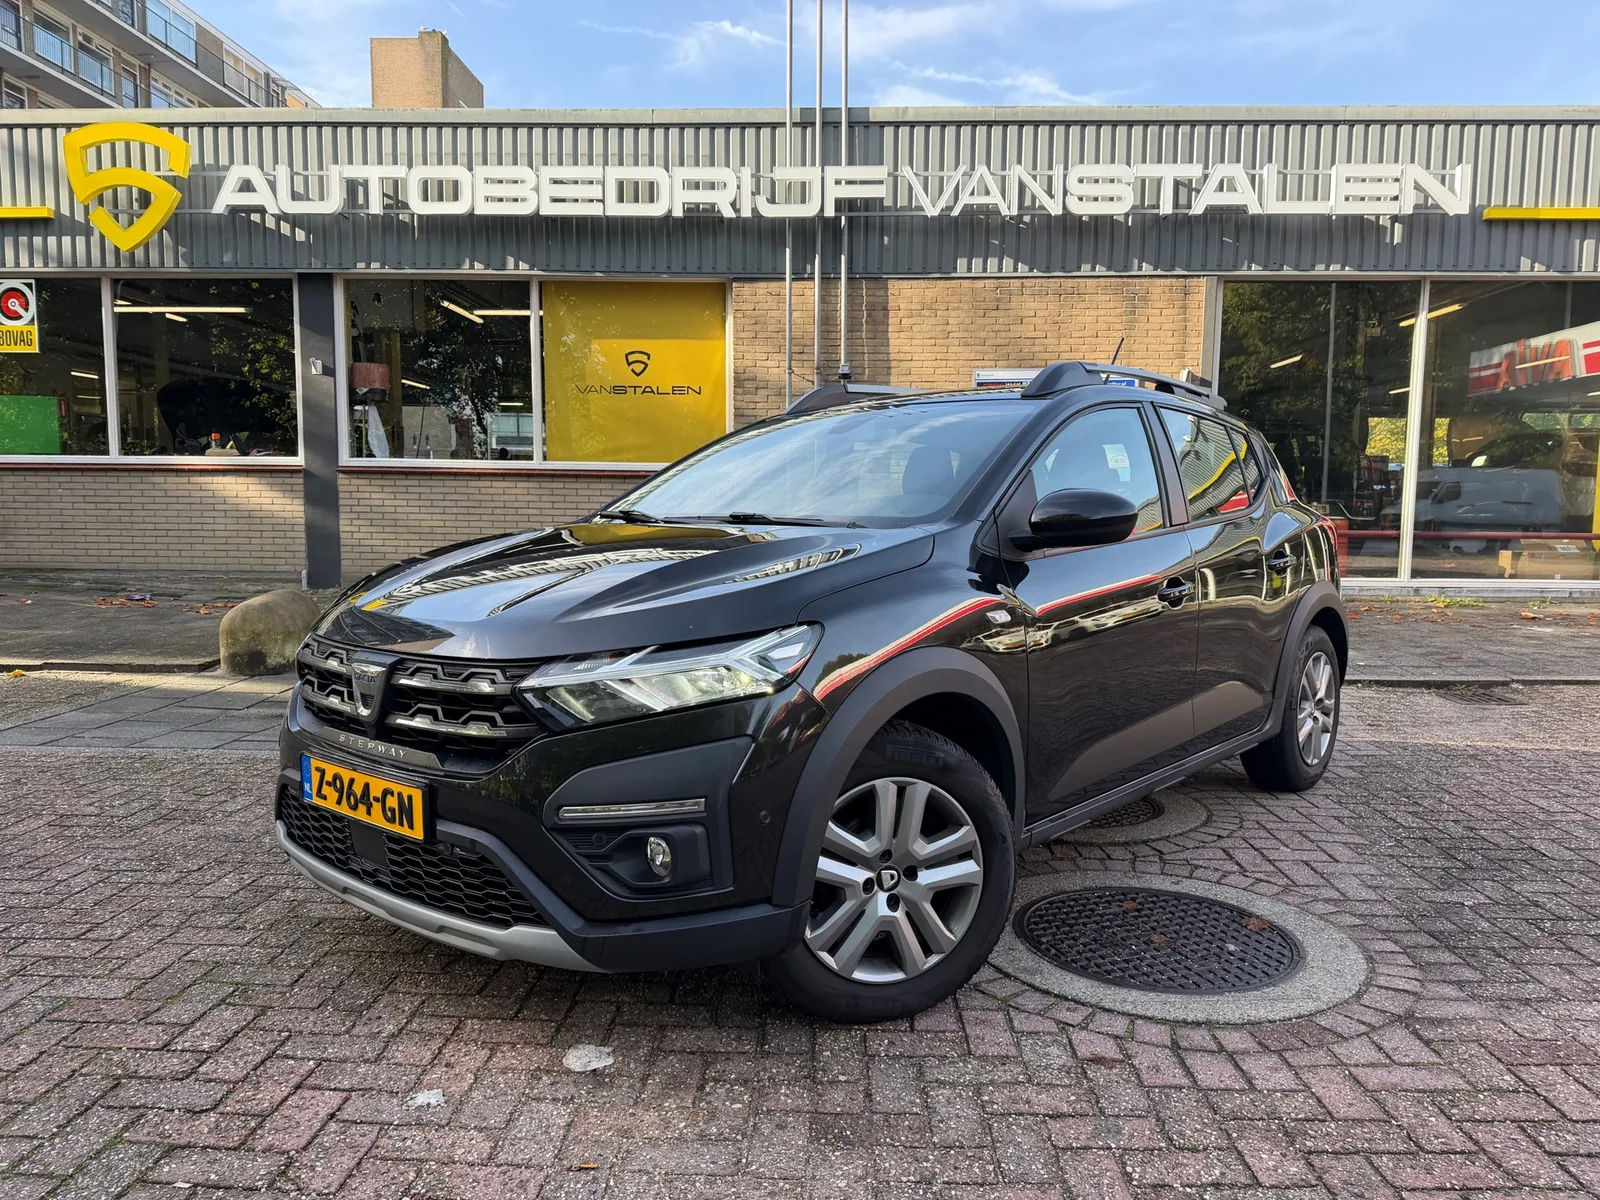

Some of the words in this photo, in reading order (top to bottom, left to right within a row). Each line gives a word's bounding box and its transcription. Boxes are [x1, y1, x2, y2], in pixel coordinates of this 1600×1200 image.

[211, 164, 888, 218] AUTOBEDRIJF
[0, 329, 33, 347] BOVAG
[339, 734, 407, 759] STEPWAY
[304, 781, 312, 794] NL
[314, 766, 415, 831] Z-964-GN
